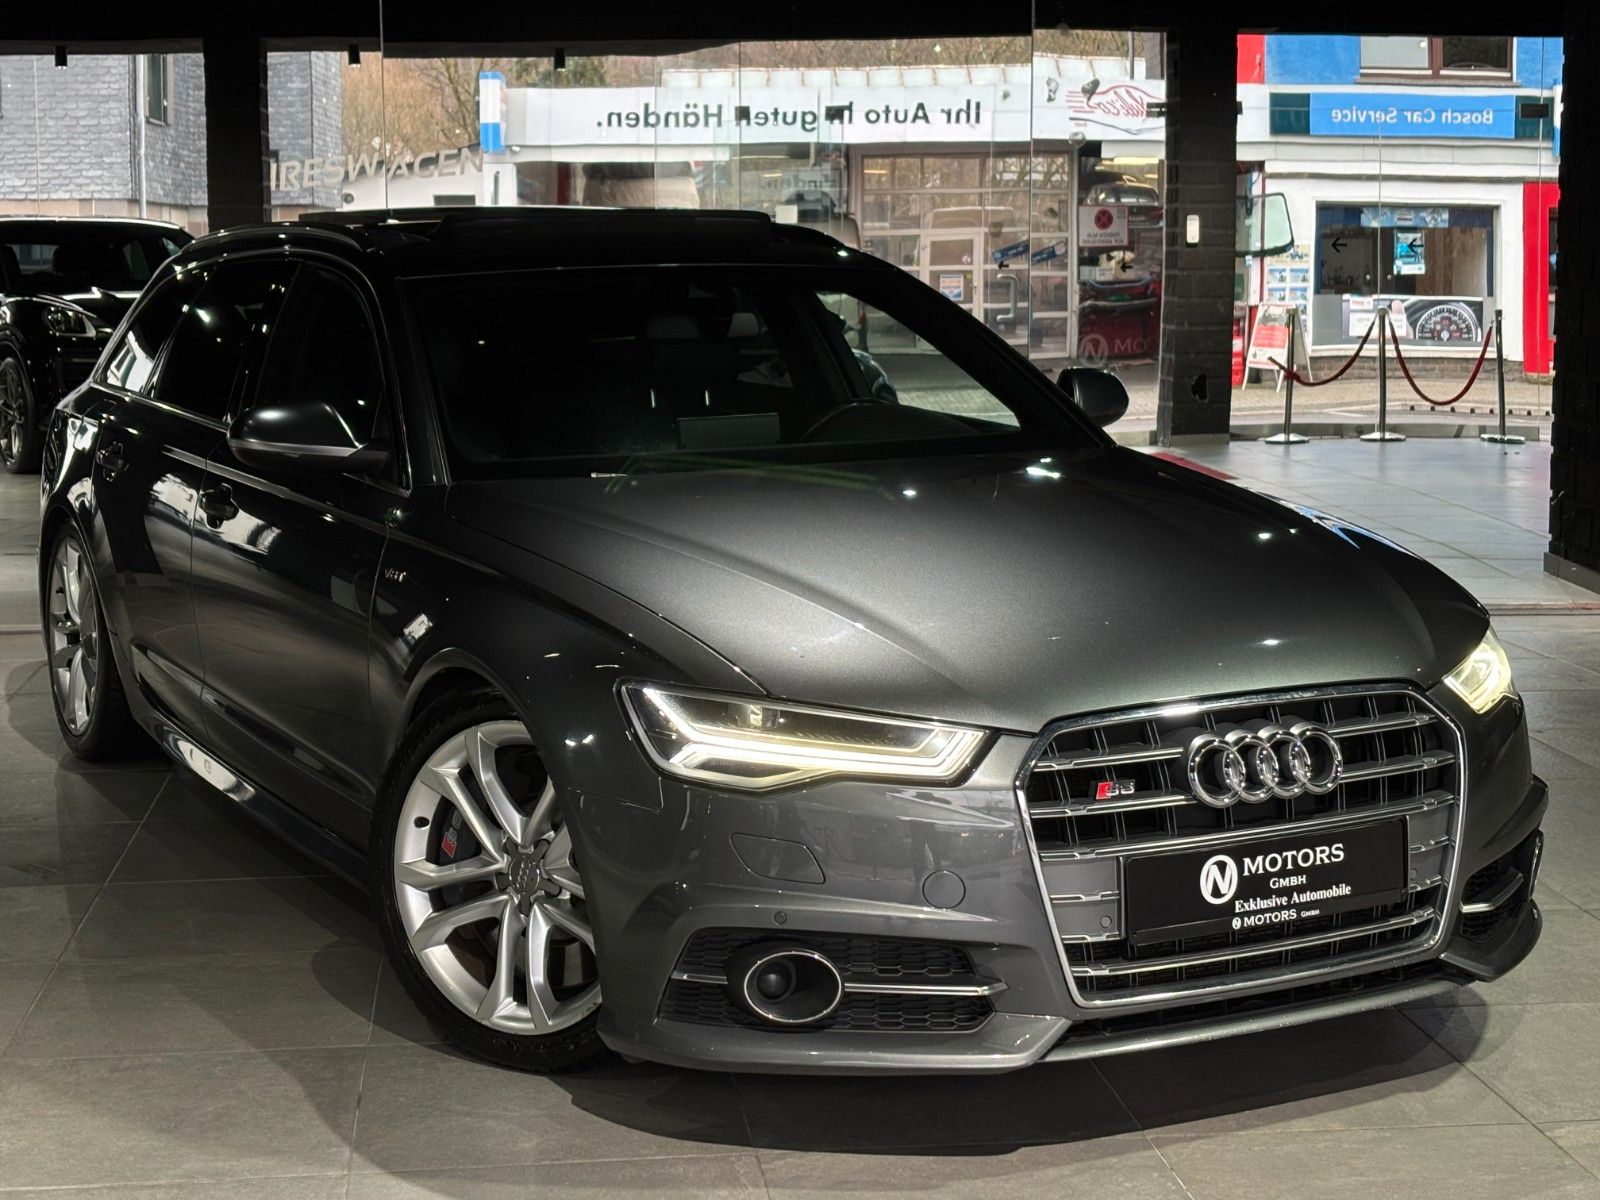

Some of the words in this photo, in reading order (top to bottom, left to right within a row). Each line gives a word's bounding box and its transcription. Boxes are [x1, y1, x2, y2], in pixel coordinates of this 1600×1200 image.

[1242, 843, 1345, 876] MOTORS
[1269, 875, 1307, 889] GMBH
[1234, 895, 1288, 913] Exklusive
[1290, 883, 1352, 905] Automobile
[1243, 909, 1298, 928] MOTORS
[1300, 909, 1320, 918] GMBH
